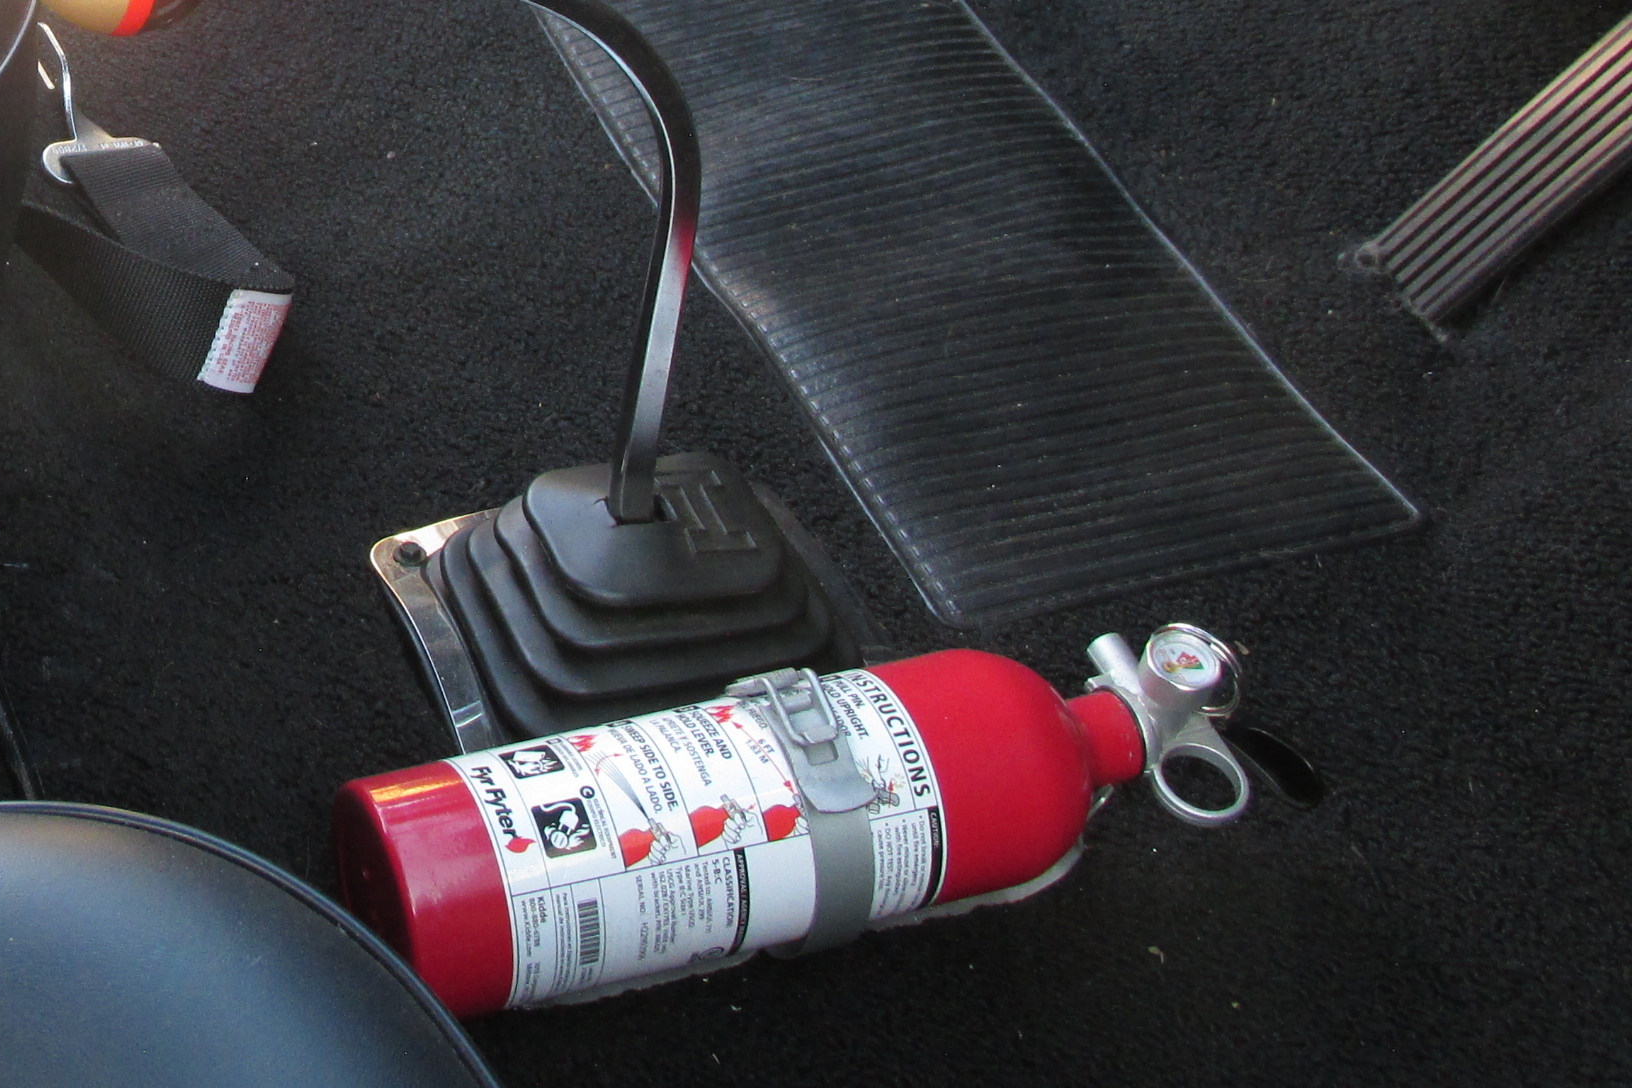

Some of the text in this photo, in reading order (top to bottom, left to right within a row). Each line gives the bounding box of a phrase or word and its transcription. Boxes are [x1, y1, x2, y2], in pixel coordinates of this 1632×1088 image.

[834, 680, 853, 696] PULL
[851, 694, 866, 710] PIN.
[655, 724, 682, 754] PALANCA.
[675, 714, 715, 758] HOLD LEVER.
[690, 710, 721, 738] SQUEEZE
[713, 738, 733, 760] AND
[836, 698, 870, 740] UPRIGHT.
[844, 671, 931, 797] INSTRUCTIONS
[622, 724, 679, 812] SWEEP SIDE TO SIDE.
[684, 741, 713, 787] SOSTENGA
[745, 739, 764, 758] 1.83
[764, 743, 776, 754] FT
[469, 765, 519, 840] Fyr Fyter
[629, 754, 648, 777] LADO
[646, 784, 664, 814] LADO.
[635, 874, 645, 901] SERIAL
[684, 865, 693, 891] Marine
[702, 861, 711, 886] Tested
[711, 858, 723, 885] 5-B:C
[735, 853, 748, 893] APPROVAL
[521, 900, 532, 957] www.Kidde.com
[537, 896, 548, 923] Kidde
